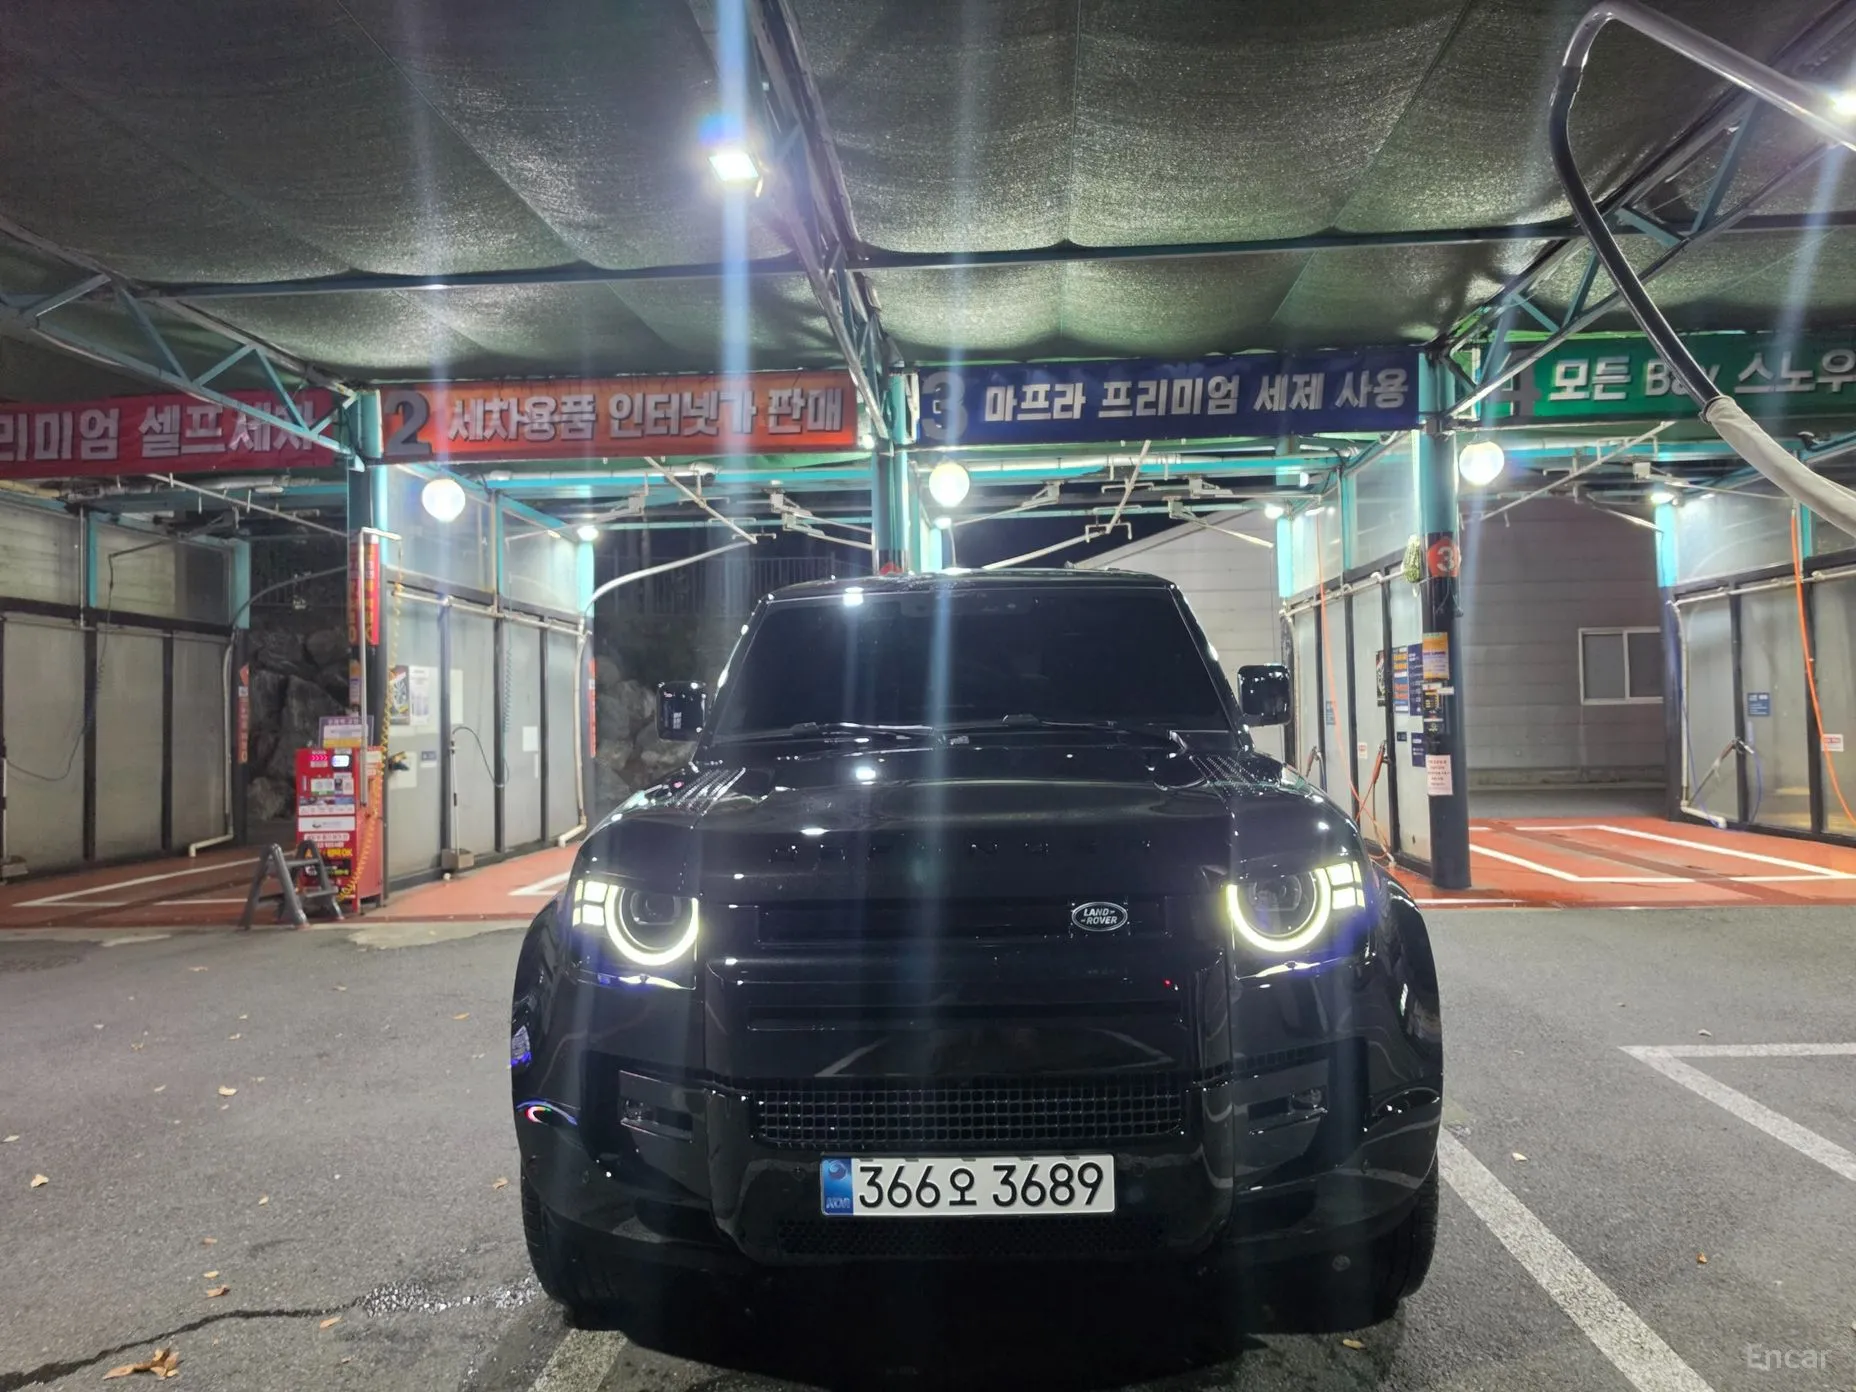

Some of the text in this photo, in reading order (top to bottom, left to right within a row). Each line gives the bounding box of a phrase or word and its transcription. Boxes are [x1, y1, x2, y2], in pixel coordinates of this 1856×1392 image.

[985, 368, 1409, 422] 마프라 프리미엄 세제 사용
[1547, 356, 1632, 401] 모든
[384, 389, 433, 454] 2
[448, 387, 842, 442] 세차용품 인터넷가 판매
[921, 372, 968, 441] 3
[1437, 546, 1455, 572] 3
[1083, 908, 1110, 917] LAND
[1086, 916, 1118, 925] ROVER
[858, 1162, 1104, 1208] 366오 3689
